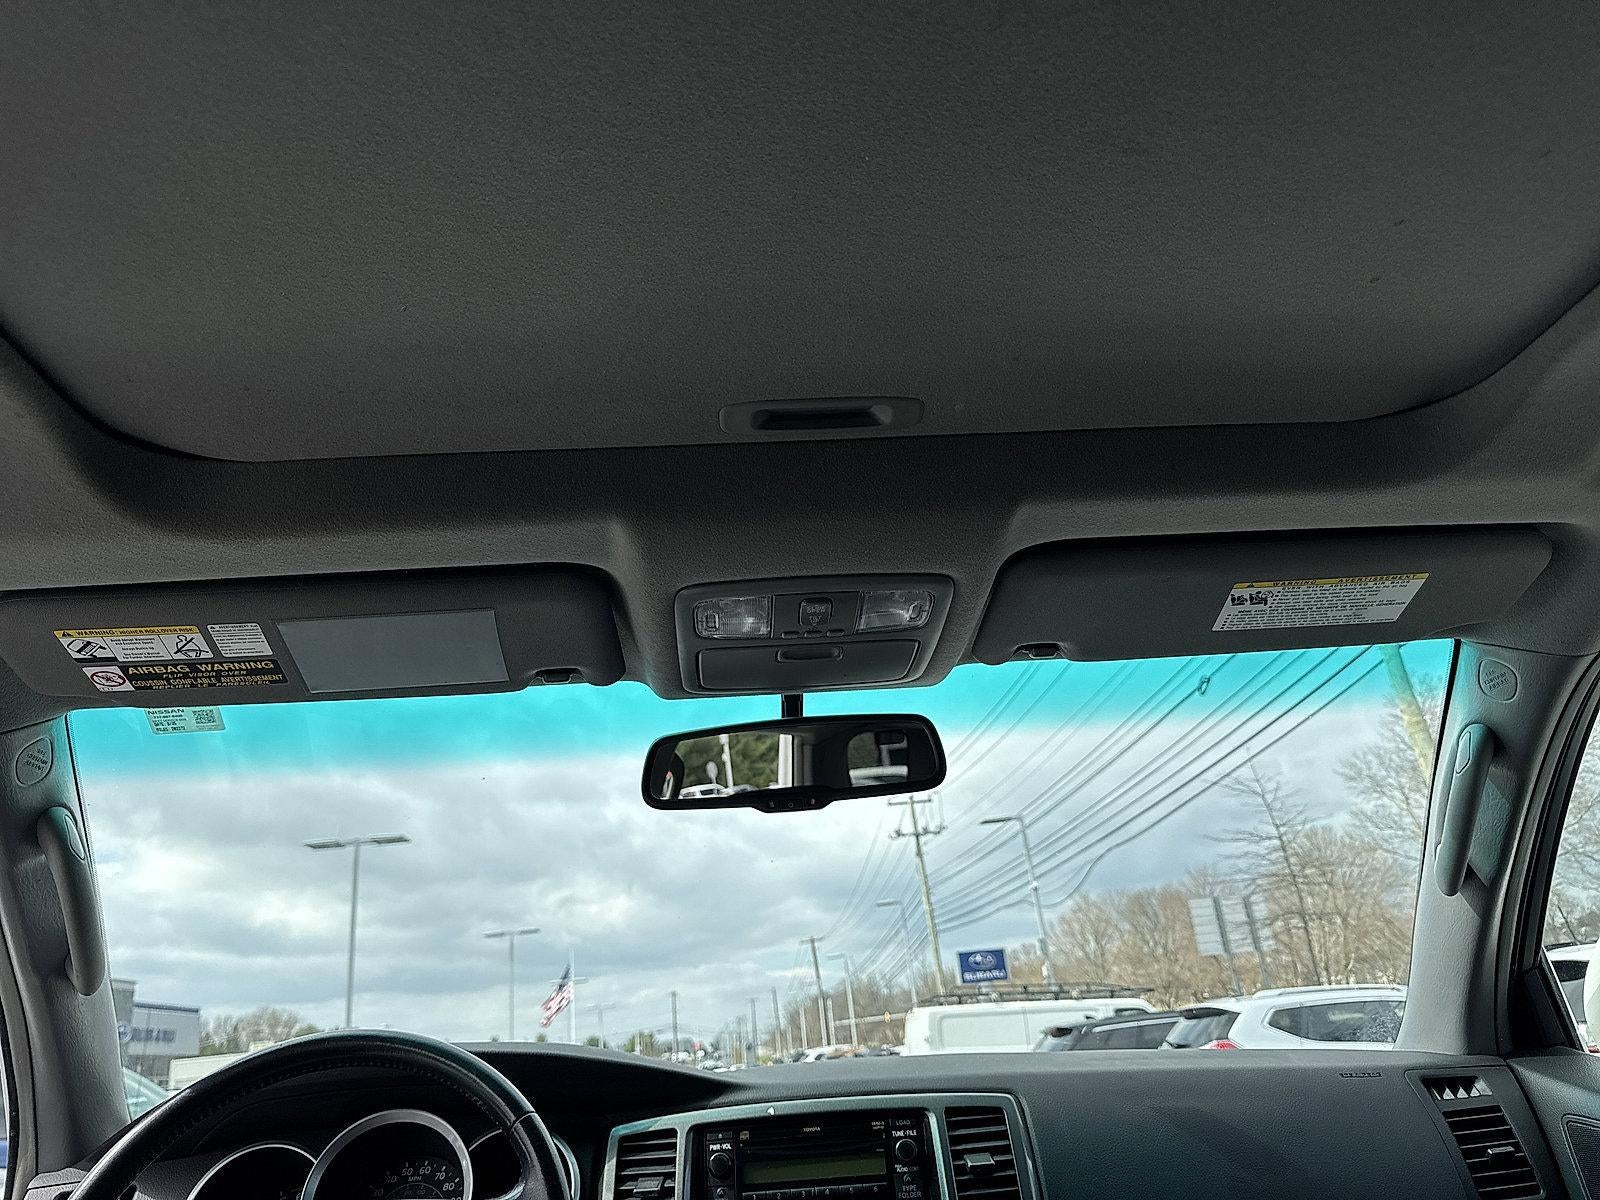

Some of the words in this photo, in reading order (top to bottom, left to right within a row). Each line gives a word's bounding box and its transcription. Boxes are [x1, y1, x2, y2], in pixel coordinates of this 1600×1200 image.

[128, 665, 190, 675] AIRBAG
[196, 661, 274, 672] WARNING
[169, 677, 217, 686] GONFLABLE
[220, 674, 283, 683] AVERTISSEMENT
[401, 1167, 414, 1176] 50
[419, 1166, 432, 1174] 60
[434, 1171, 446, 1181] 70
[442, 1182, 455, 1191] 80
